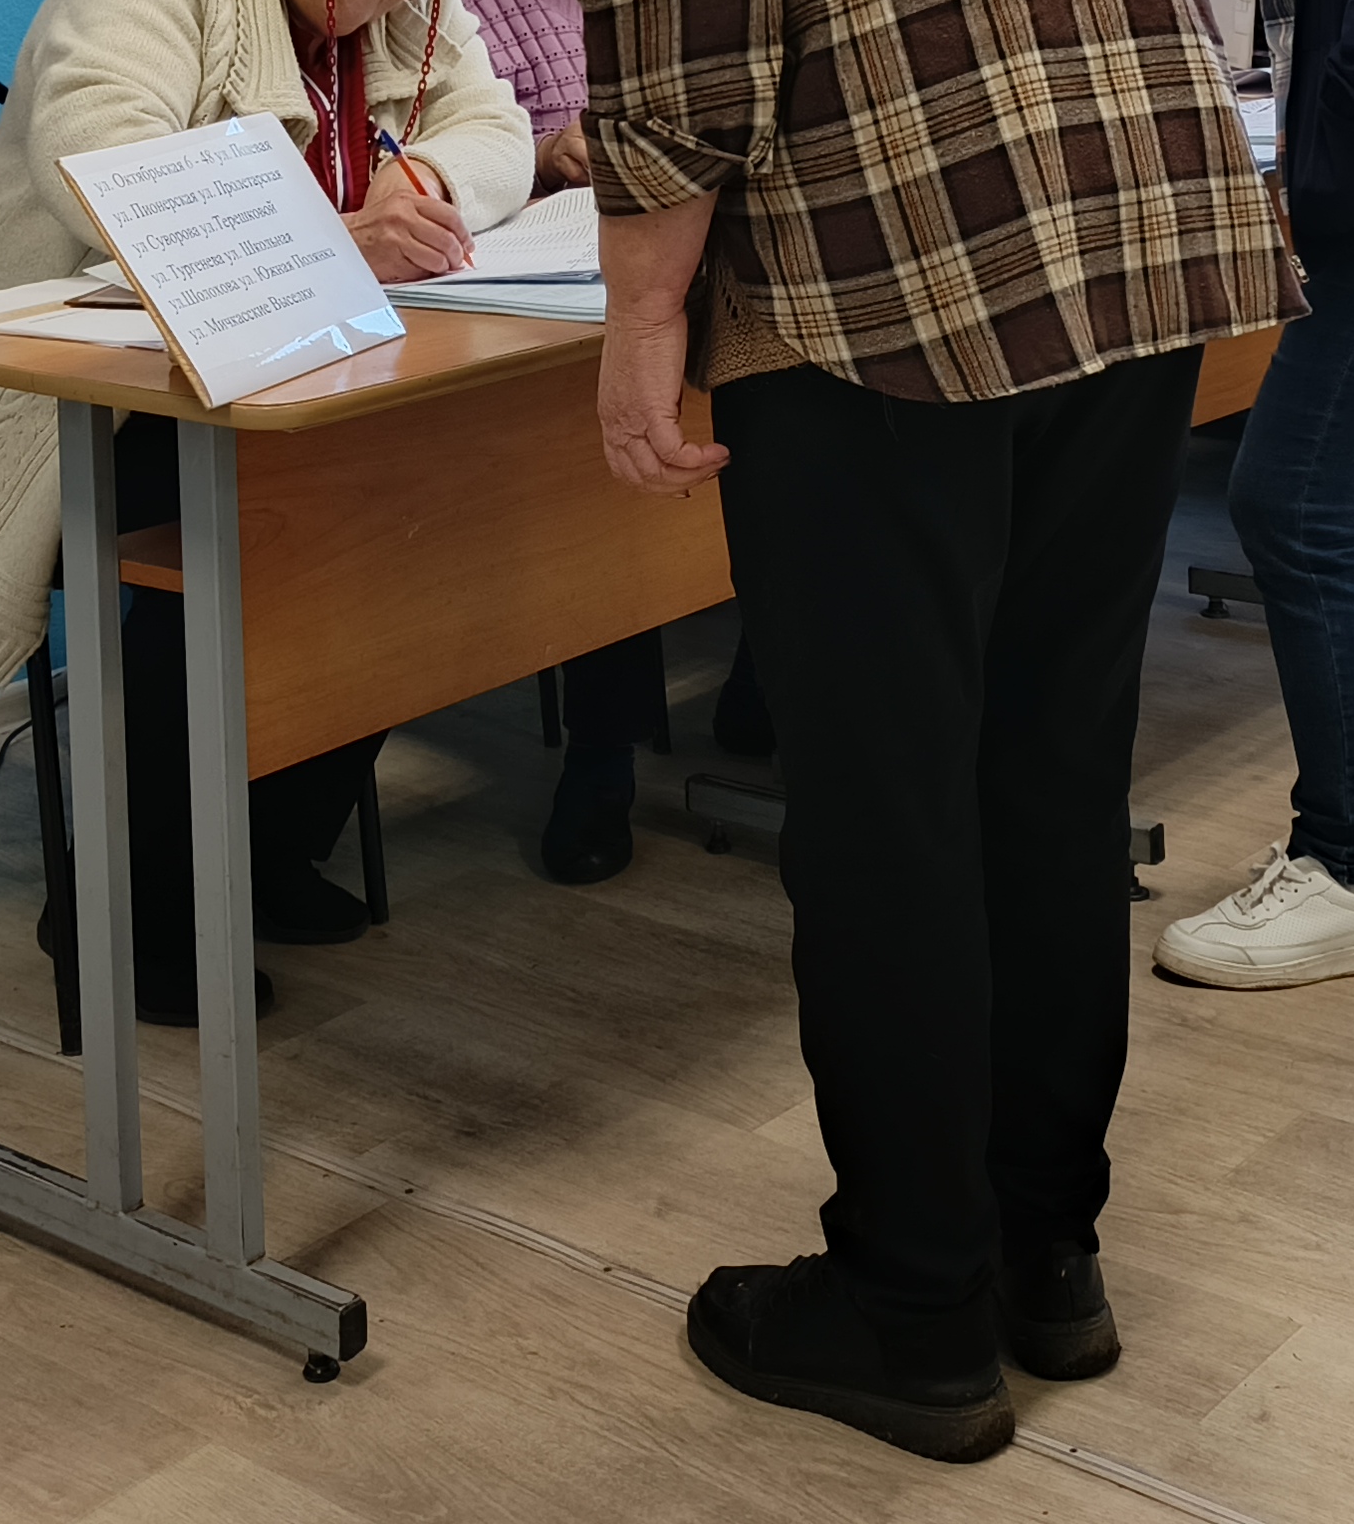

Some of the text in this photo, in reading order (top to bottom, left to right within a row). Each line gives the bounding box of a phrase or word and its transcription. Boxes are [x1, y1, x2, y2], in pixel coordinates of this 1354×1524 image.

[94, 180, 114, 197] ул.
[111, 161, 185, 190] Октябрьская
[183, 155, 194, 170] 6
[113, 210, 133, 228] ул.
[130, 190, 198, 221] Пионерская
[197, 187, 216, 204] ул.
[146, 224, 201, 252] Суворова
[151, 231, 294, 288] ул. Тургенева ул. Школьная
[238, 274, 258, 291] ул.
[255, 261, 295, 282] Южная
[189, 287, 316, 346] ул. Мичкасские Выселки
